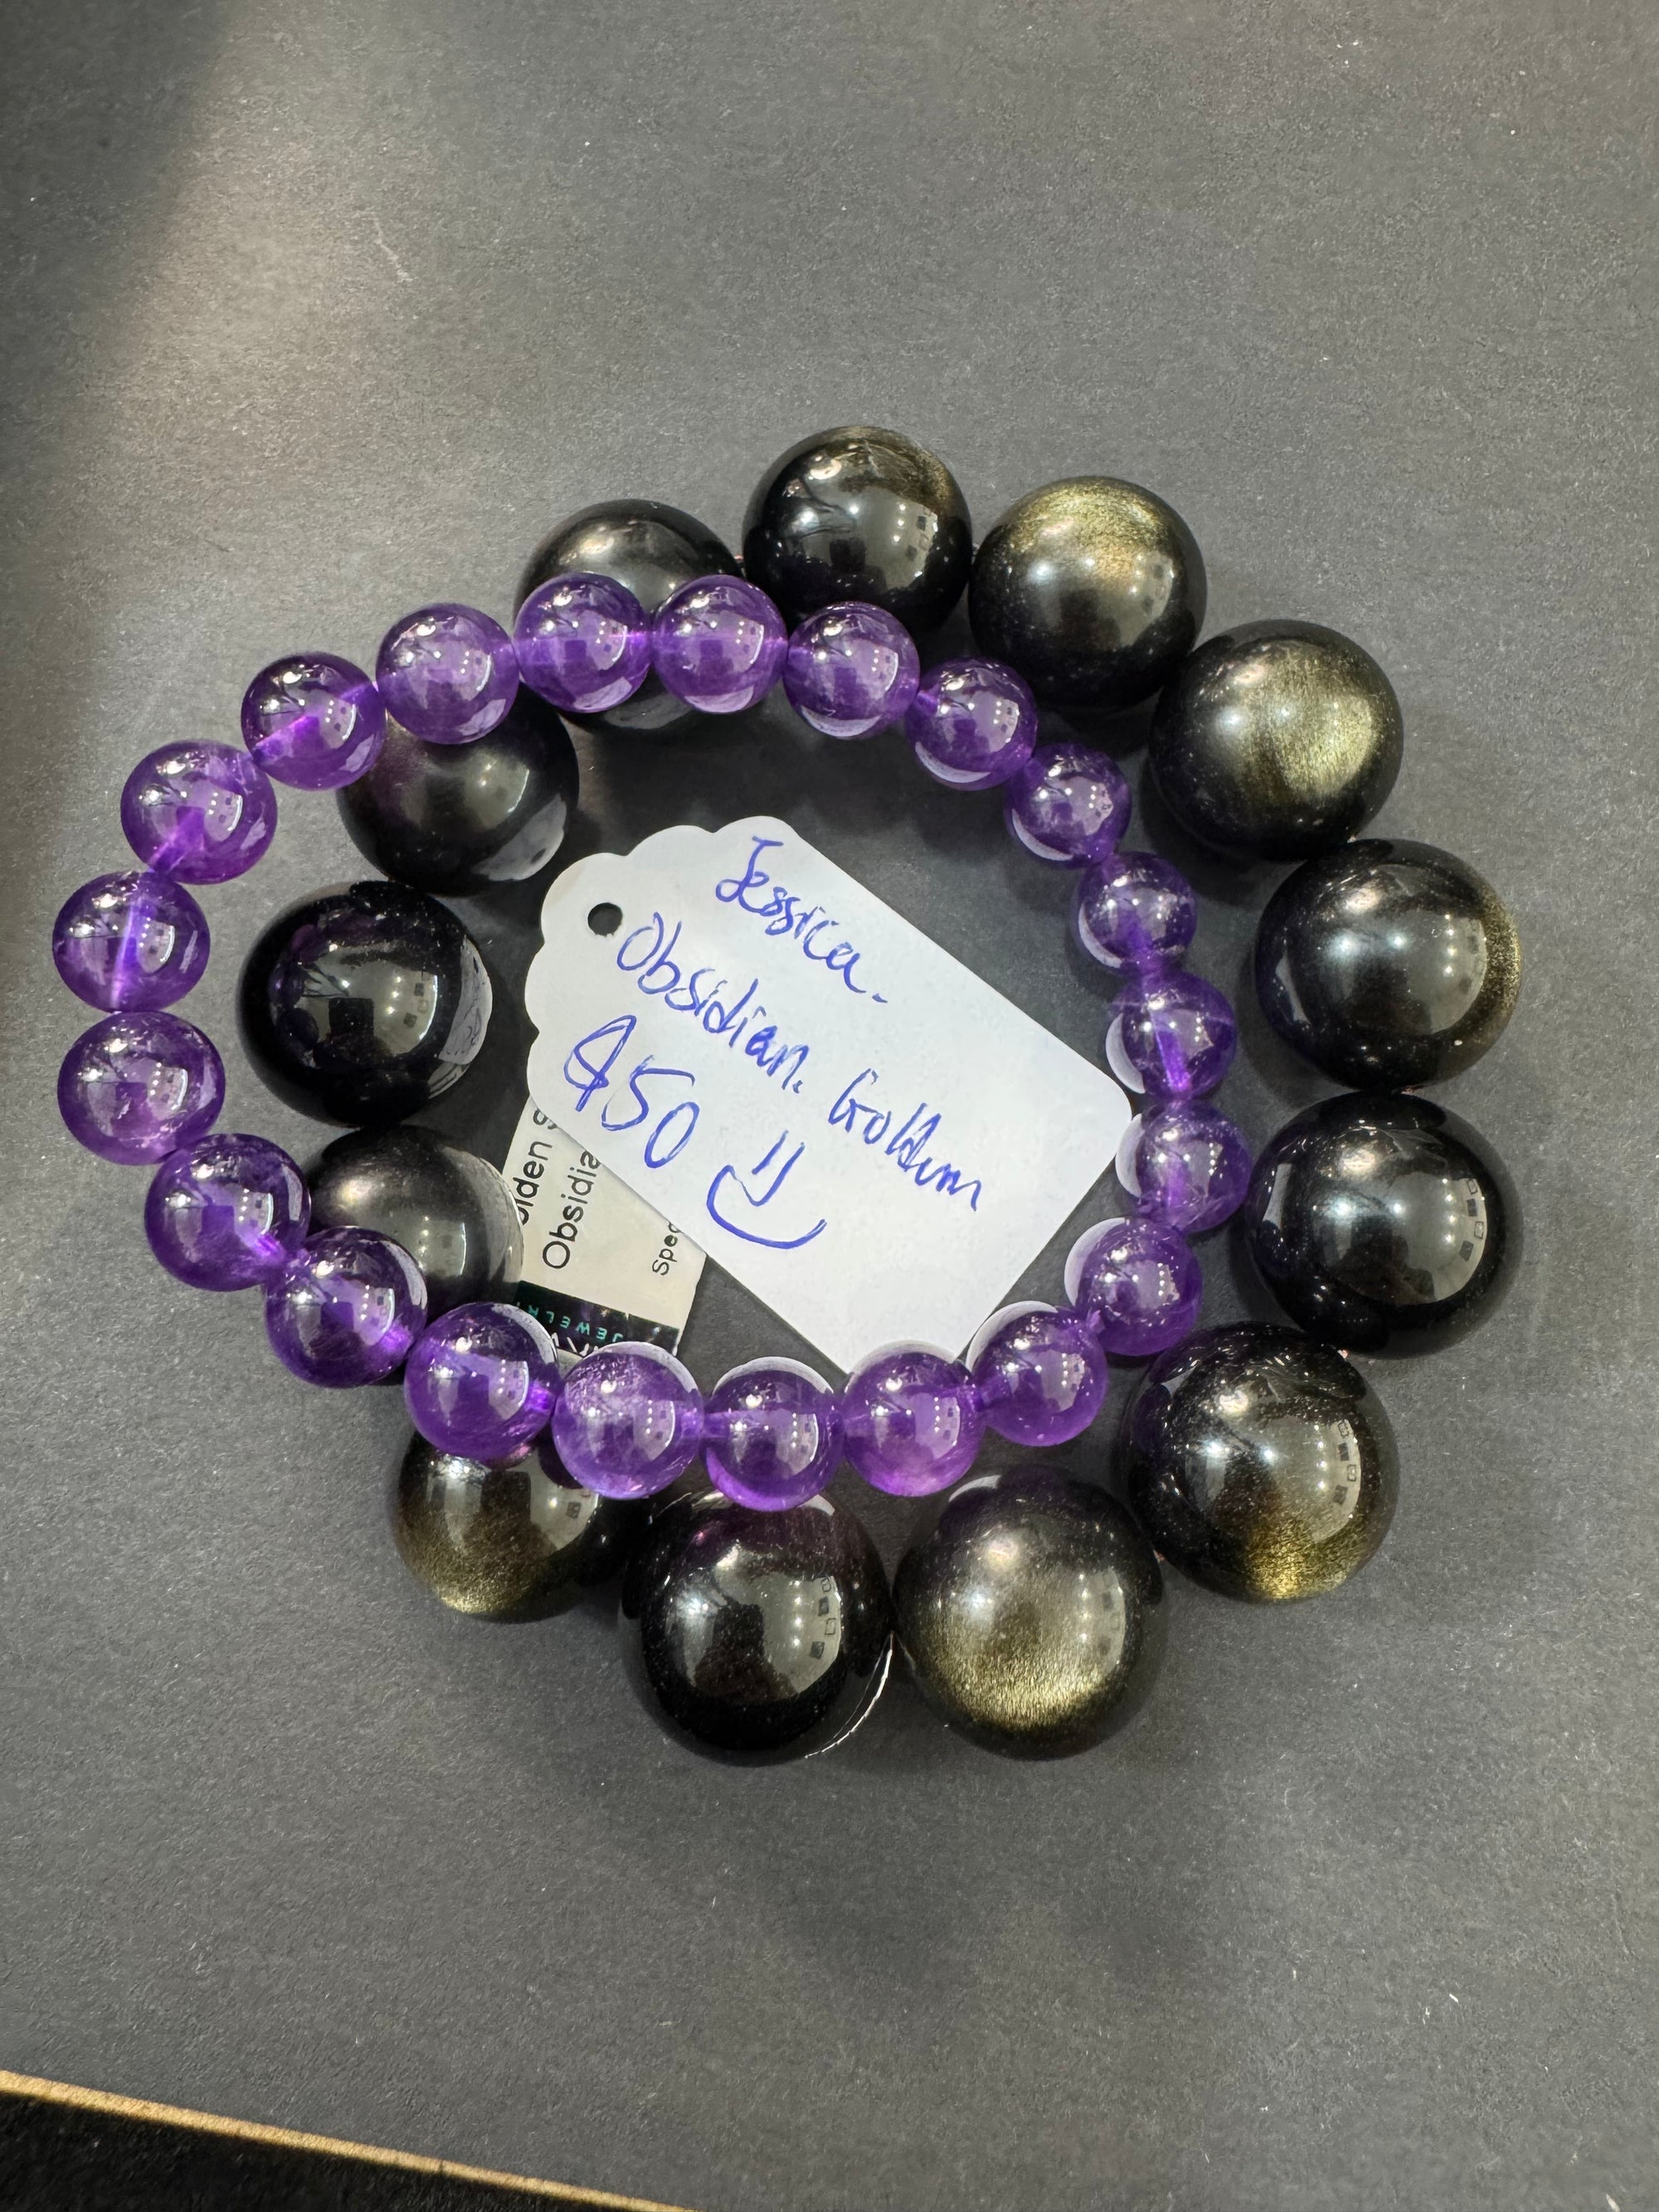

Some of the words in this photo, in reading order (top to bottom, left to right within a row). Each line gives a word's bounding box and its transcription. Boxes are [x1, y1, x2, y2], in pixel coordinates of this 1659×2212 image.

[563, 1014, 699, 1169] $50
[542, 1150, 602, 1269] Obsidia
[515, 1302, 624, 1342] JEWELR
